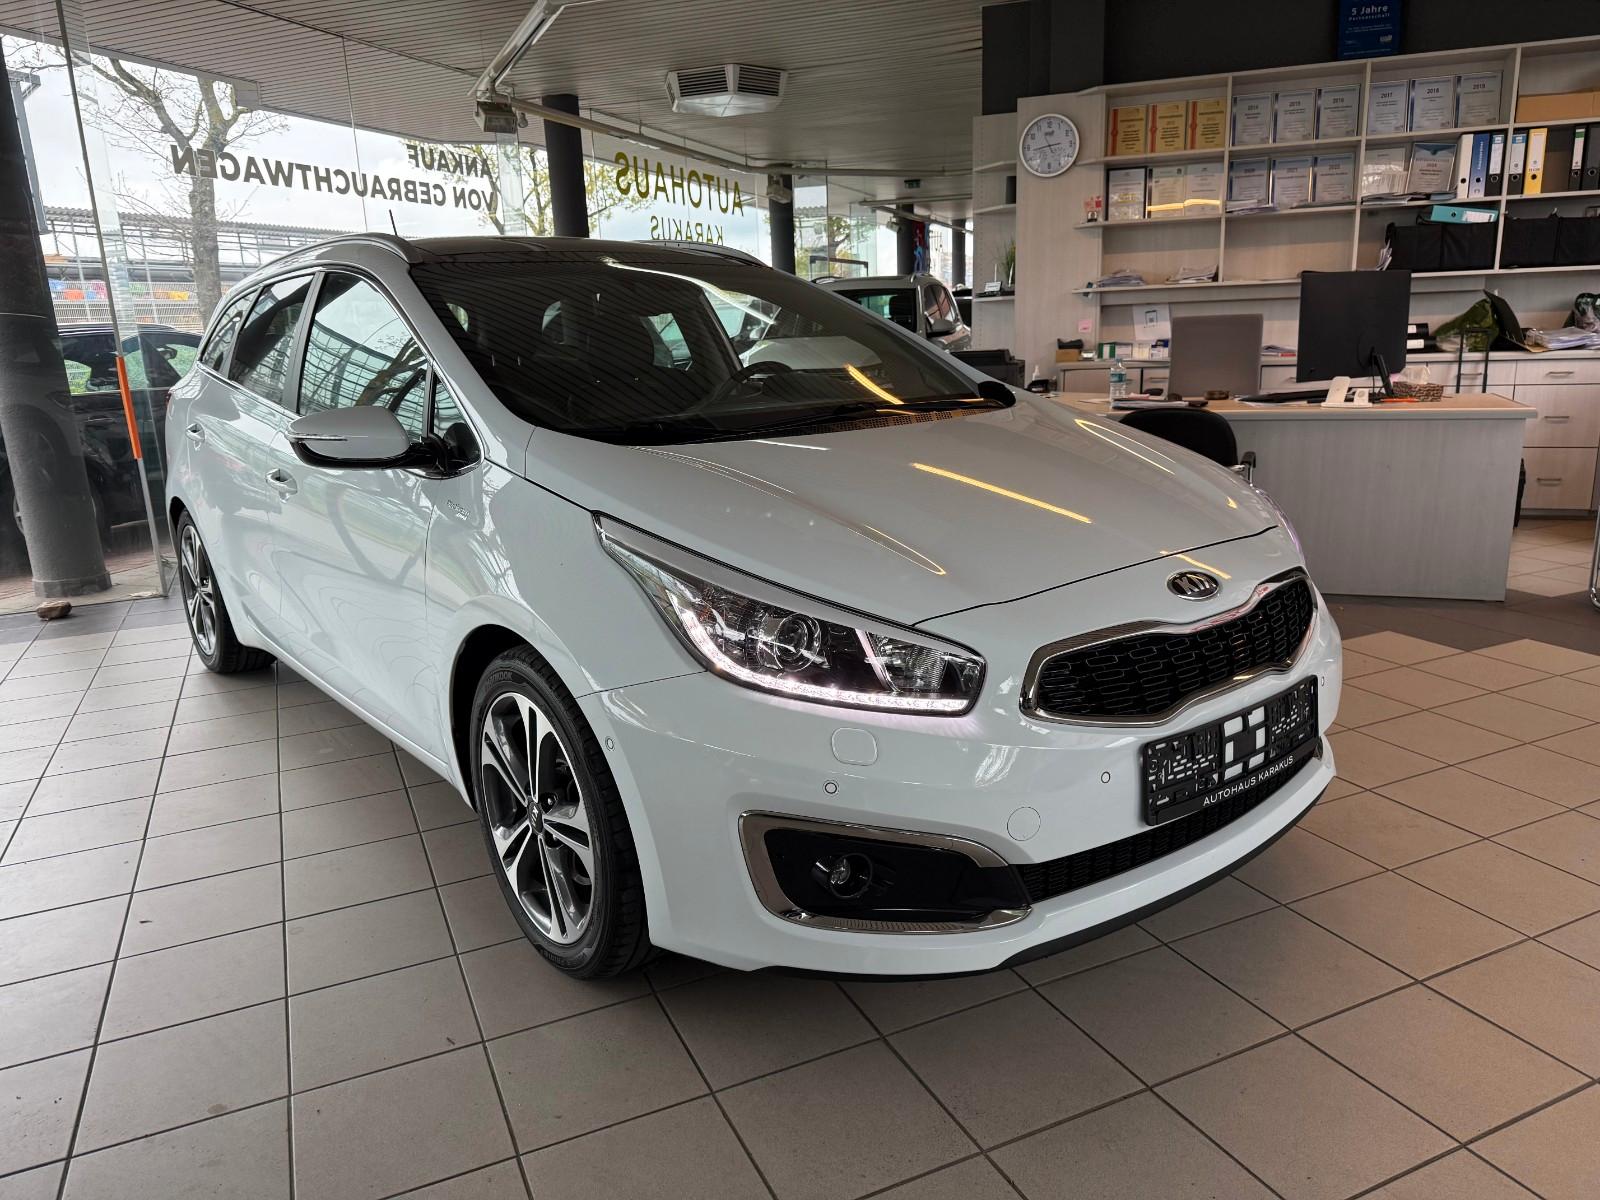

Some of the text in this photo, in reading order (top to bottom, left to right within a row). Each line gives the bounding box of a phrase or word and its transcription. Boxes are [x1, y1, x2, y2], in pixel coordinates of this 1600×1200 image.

[1360, 5, 1389, 15] Jahre
[1202, 755, 1294, 807] AUTOHAUS KARAKUS
